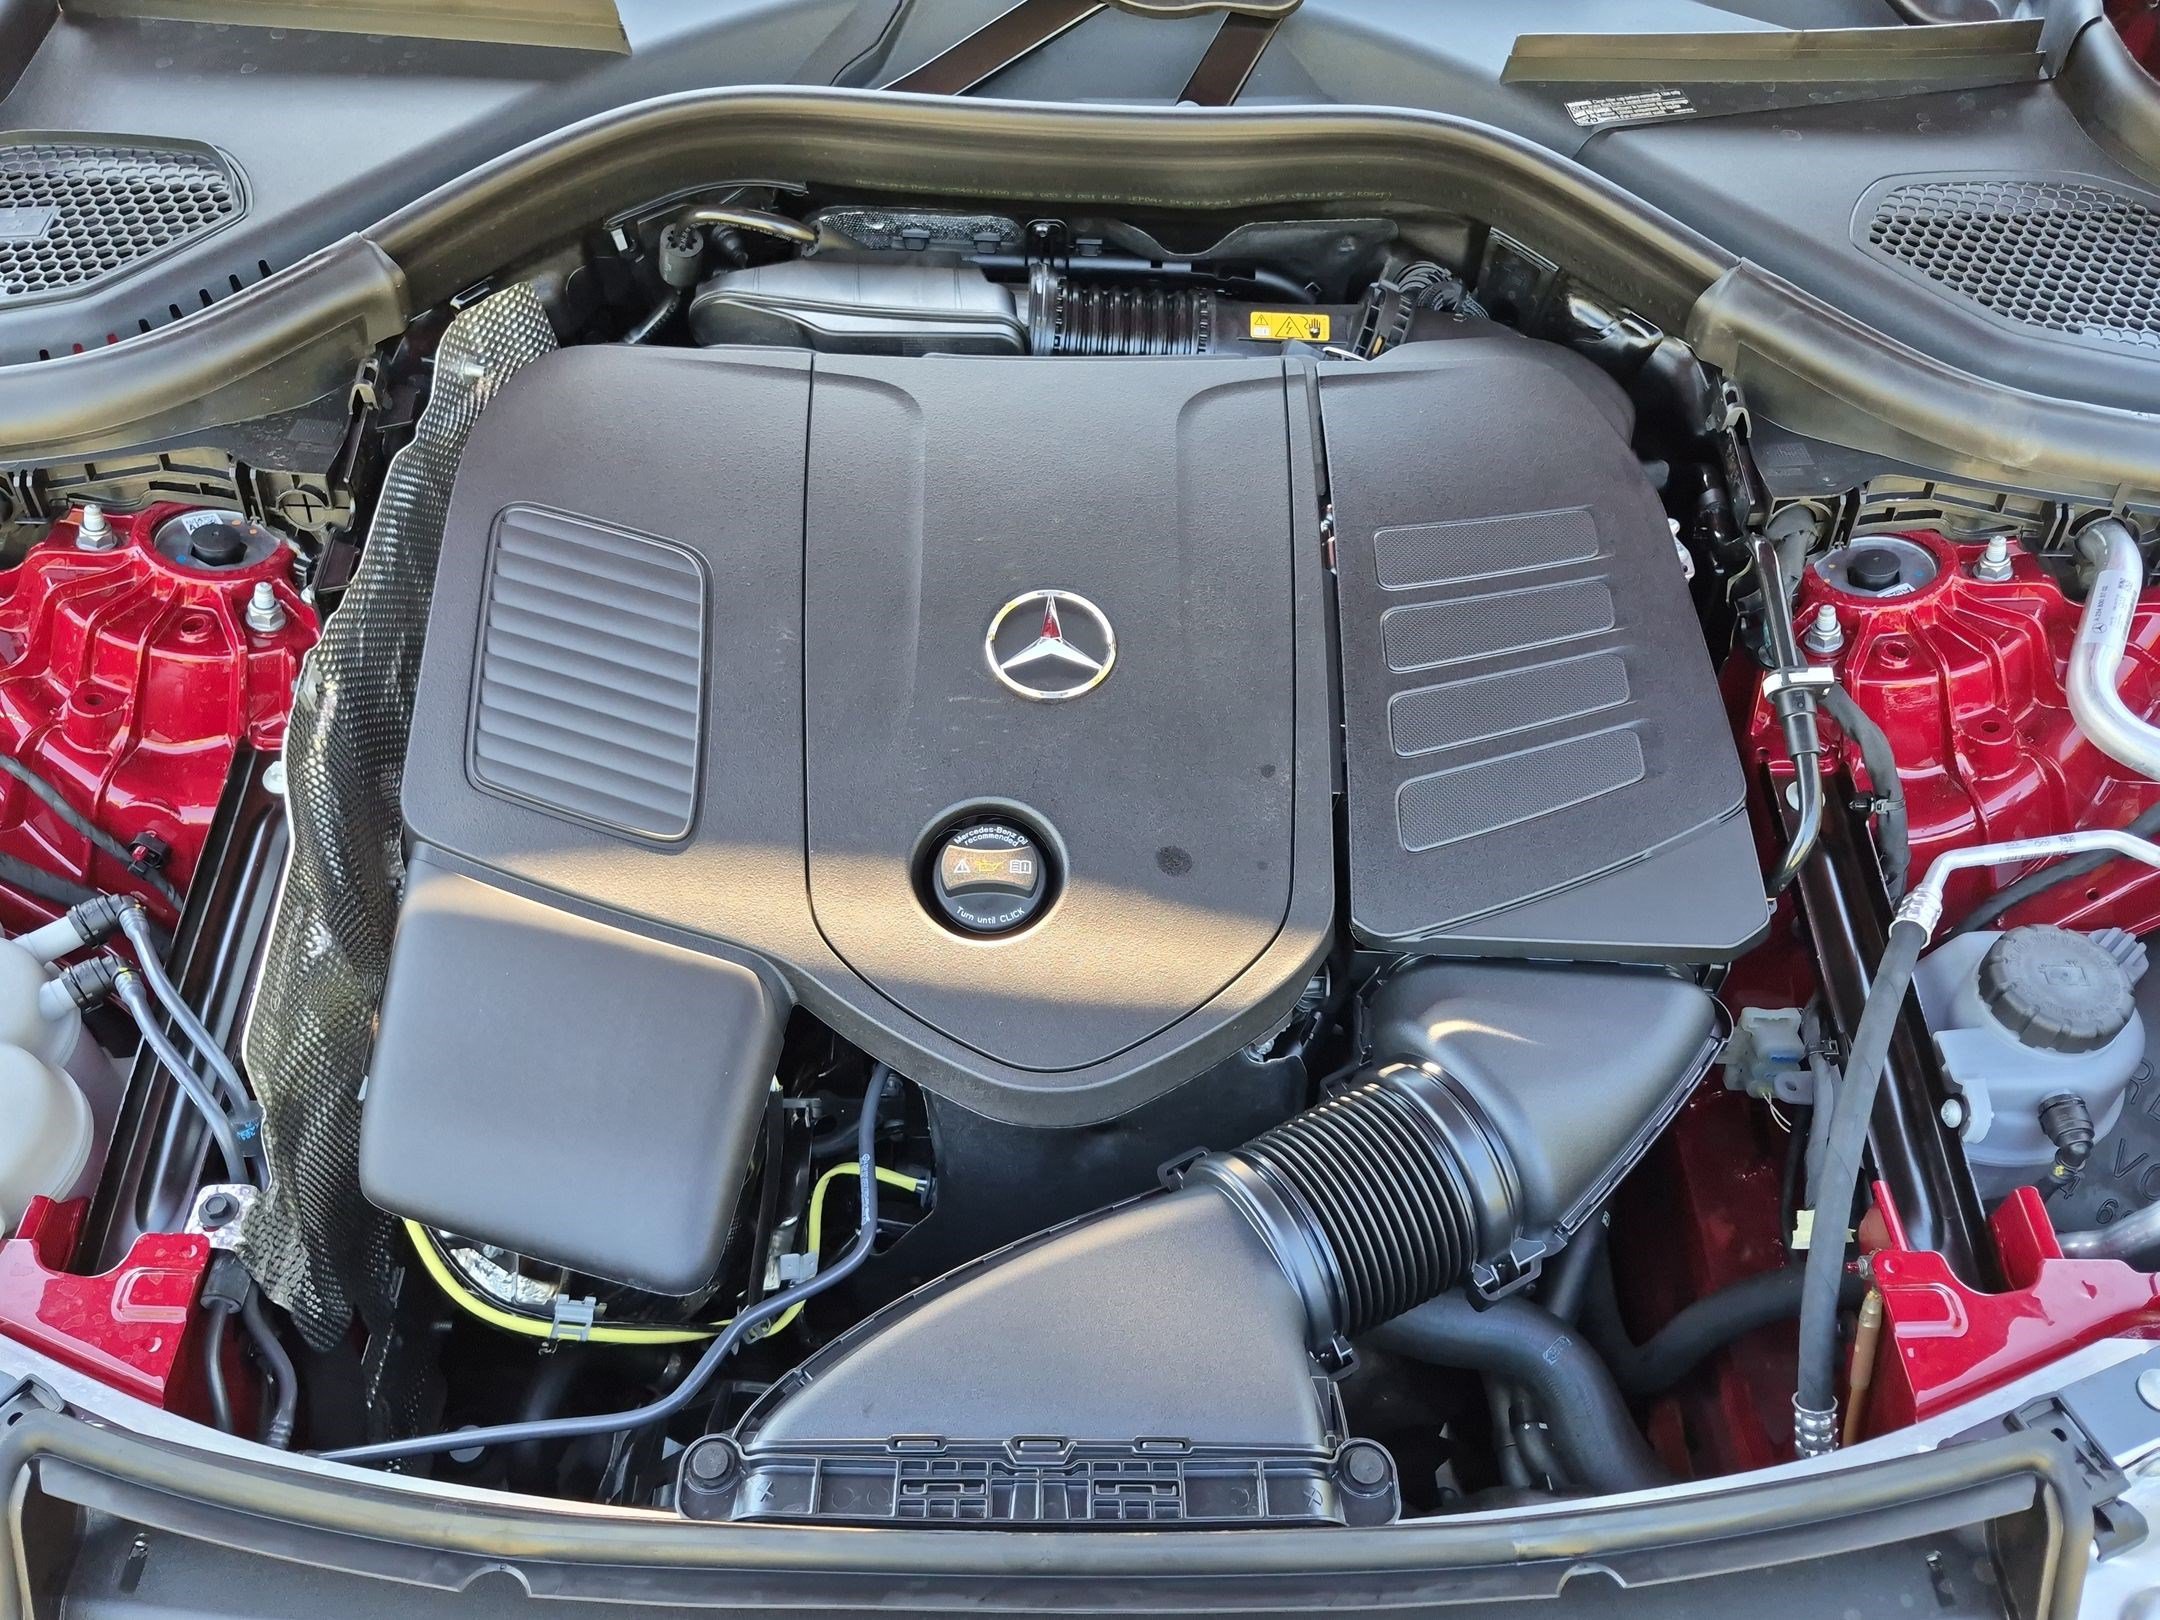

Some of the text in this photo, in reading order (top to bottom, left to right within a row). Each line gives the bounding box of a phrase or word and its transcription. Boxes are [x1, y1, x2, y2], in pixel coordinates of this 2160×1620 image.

[953, 826, 1029, 846] Mercedes-Benz Oil
[964, 833, 1019, 847] recommended
[956, 905, 1026, 924] Turn until CLICK
